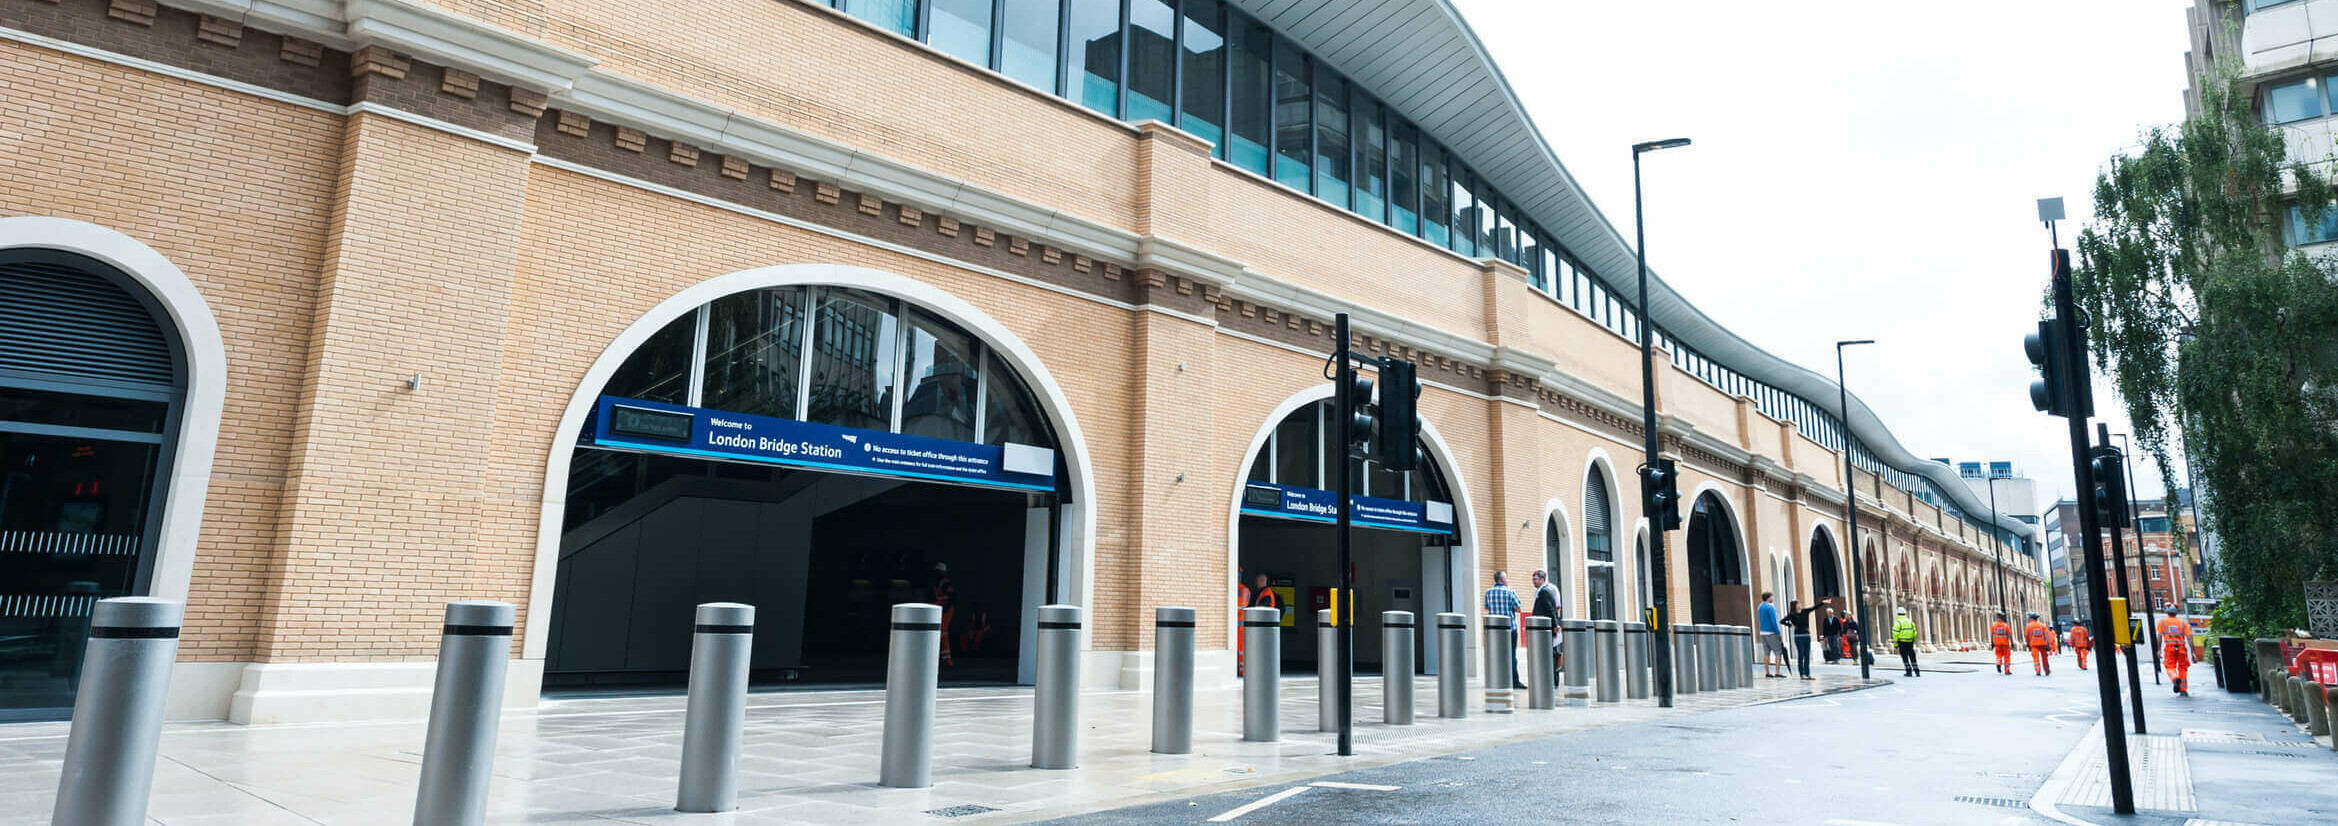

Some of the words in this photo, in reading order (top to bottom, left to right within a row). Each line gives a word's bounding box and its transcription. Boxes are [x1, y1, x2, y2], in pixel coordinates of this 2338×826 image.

[710, 417, 743, 429] Welcome
[744, 422, 753, 430] to
[708, 431, 756, 449] London
[759, 436, 798, 456] Bridge
[801, 442, 842, 458] Station
[1286, 500, 1308, 511] London
[1309, 502, 1327, 514] Bridge
